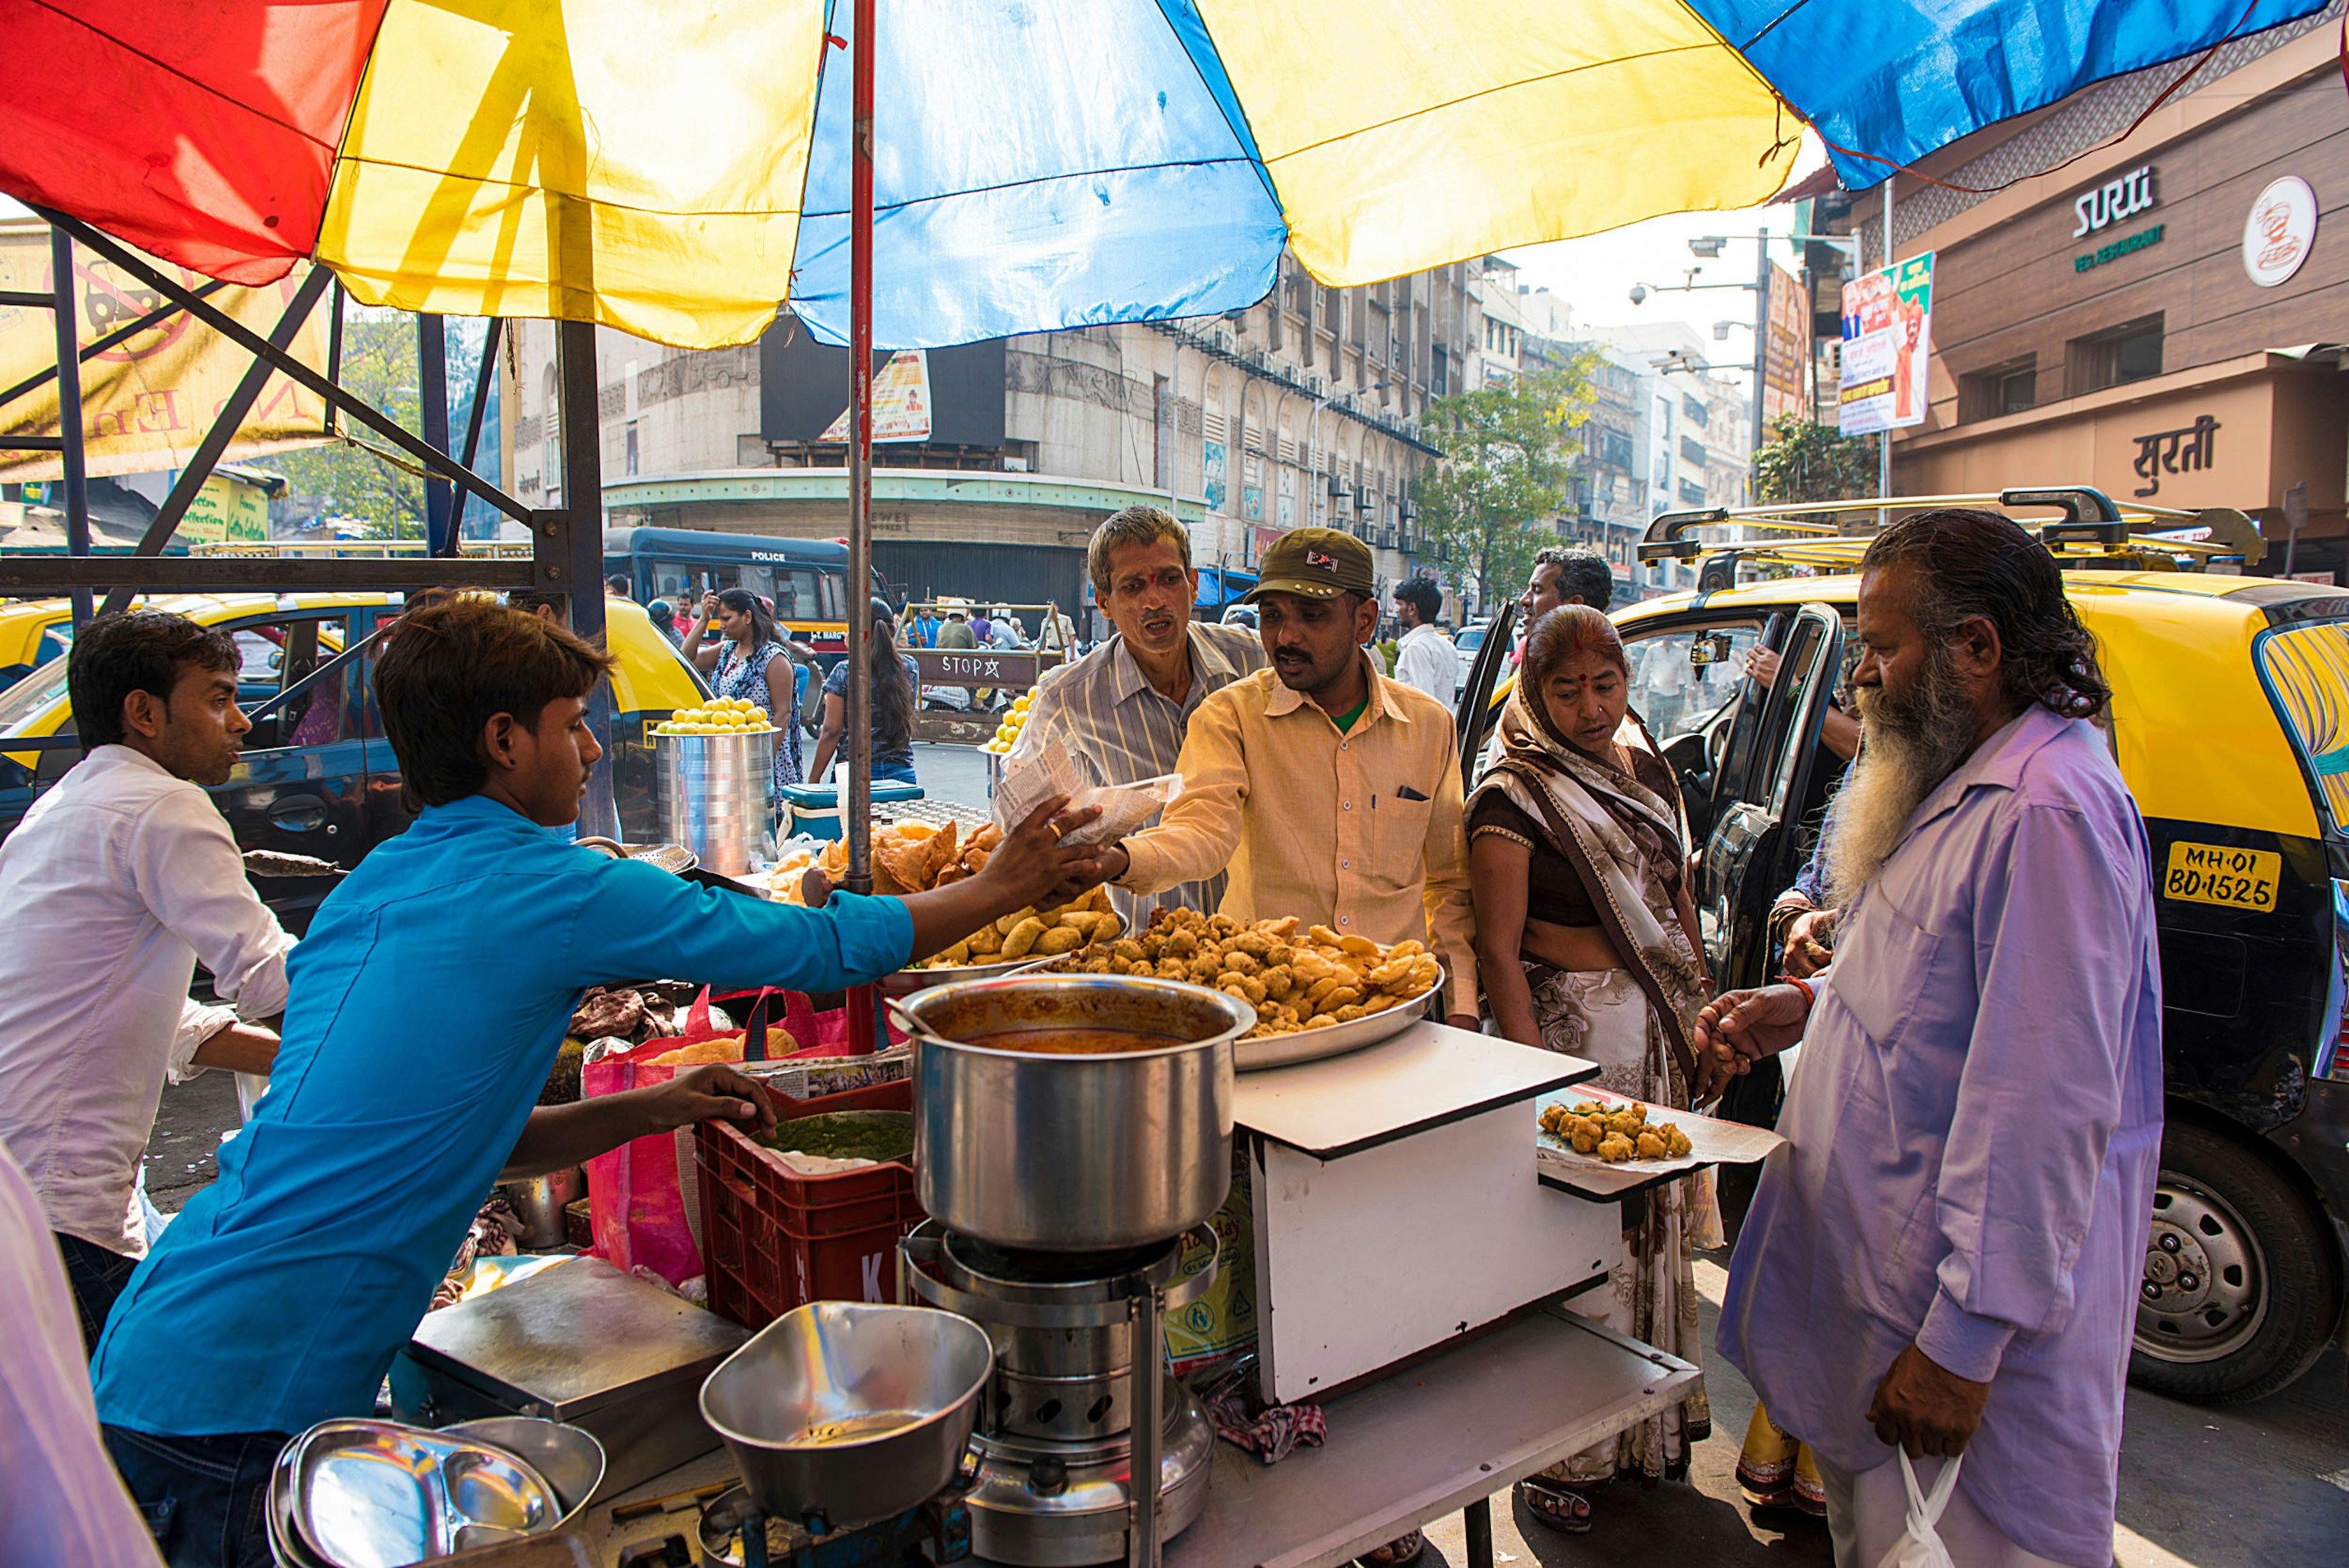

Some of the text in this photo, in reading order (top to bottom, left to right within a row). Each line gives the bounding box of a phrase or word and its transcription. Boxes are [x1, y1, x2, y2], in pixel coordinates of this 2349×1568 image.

[2096, 224, 2165, 264] RESTAURANT
[2133, 415, 2221, 497] सुरती
[751, 552, 785, 561] POLICE
[823, 631, 842, 640] MARG
[943, 656, 982, 676] STOP
